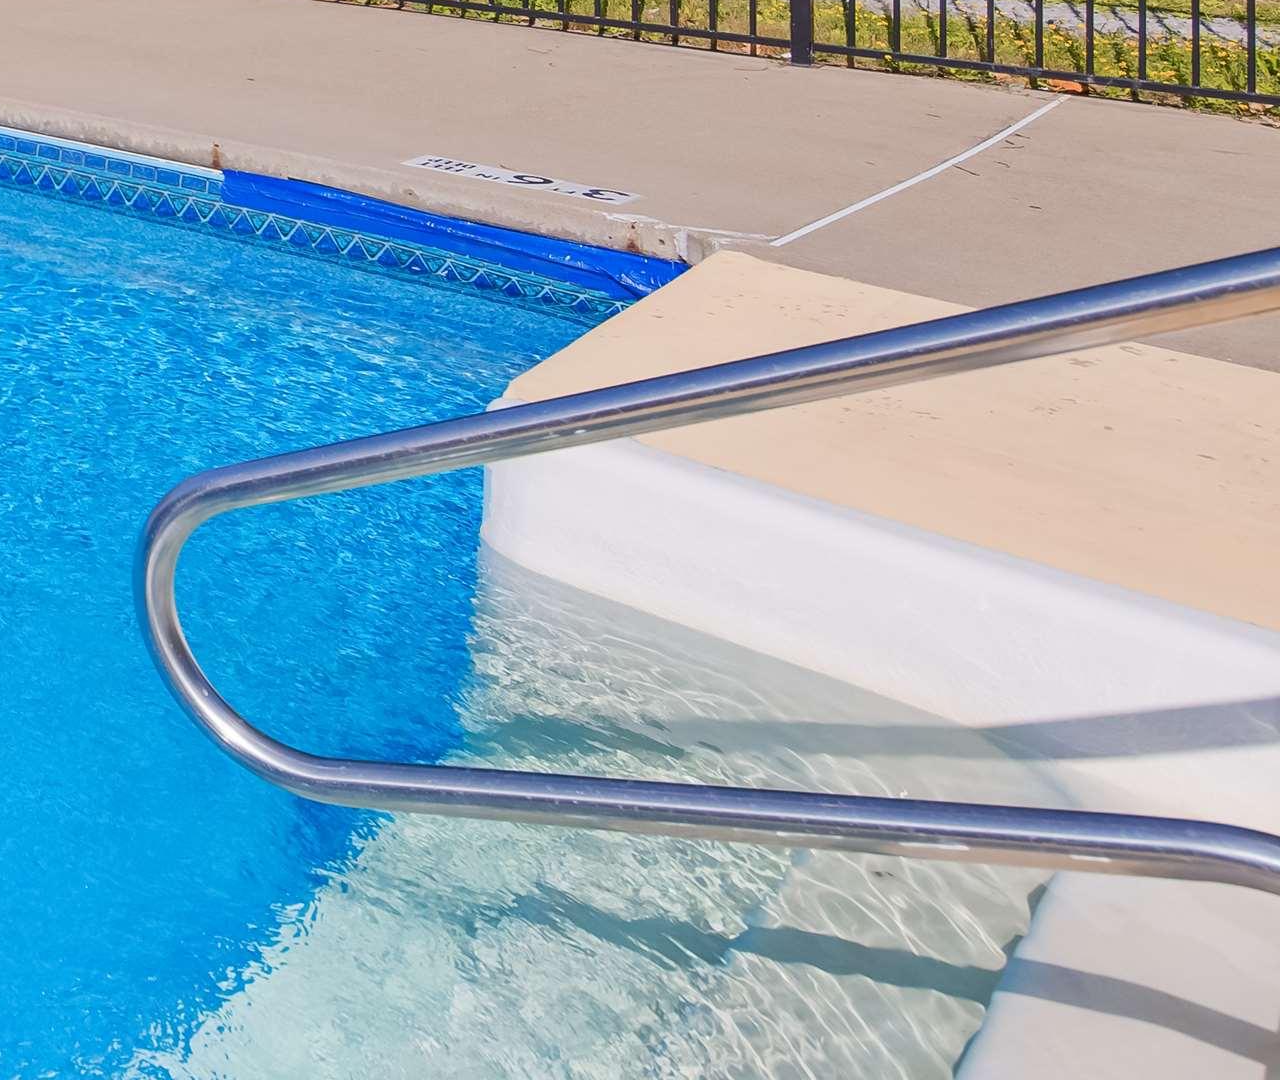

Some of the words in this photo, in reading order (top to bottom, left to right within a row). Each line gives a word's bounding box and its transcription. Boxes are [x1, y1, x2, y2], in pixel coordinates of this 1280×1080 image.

[475, 172, 500, 180] IN
[507, 174, 554, 185] 6
[582, 188, 630, 201] 3
